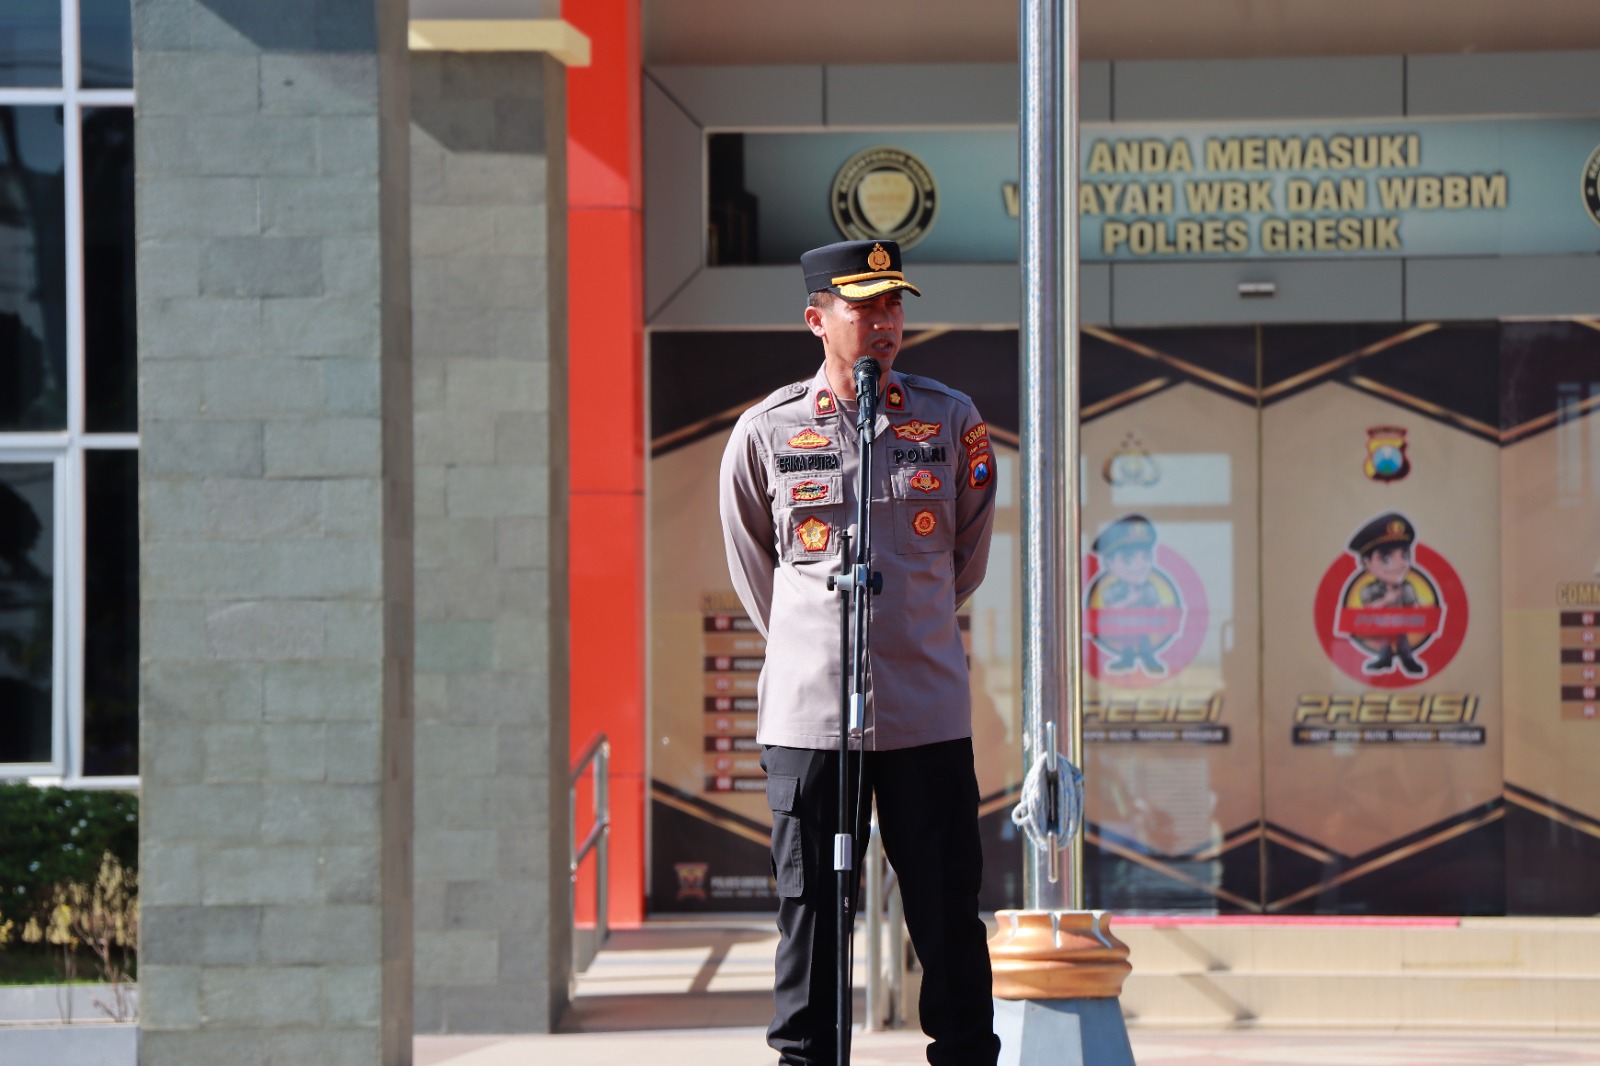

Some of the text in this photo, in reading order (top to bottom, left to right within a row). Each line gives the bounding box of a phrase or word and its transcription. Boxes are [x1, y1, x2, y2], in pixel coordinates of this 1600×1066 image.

[1088, 134, 1420, 174] ANDA MEMASUKI
[1003, 173, 1507, 217] AYAH WBK DAN WBBM
[1103, 217, 1402, 255] POLRES GRESIK
[777, 453, 840, 472] ERIKA PUTRA
[893, 446, 947, 464] POLRI
[1083, 694, 1223, 722] RESISI
[1296, 693, 1478, 722] PRESISI
